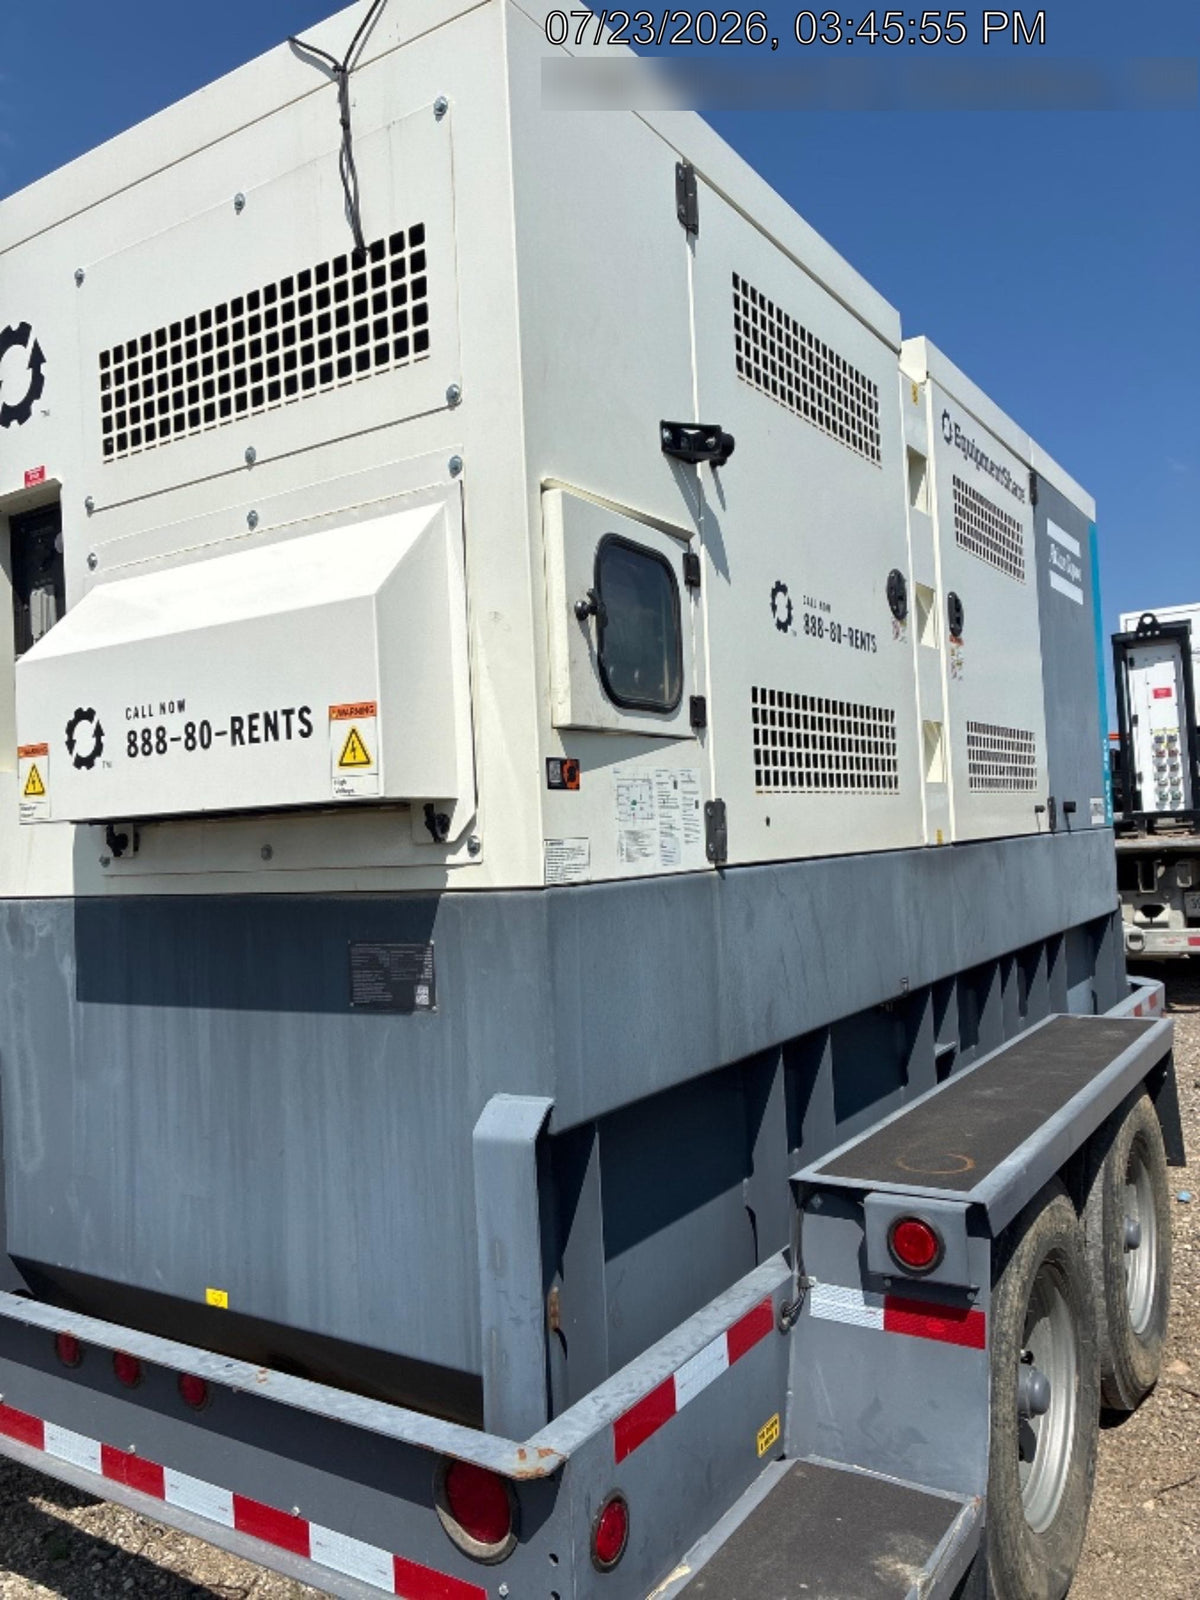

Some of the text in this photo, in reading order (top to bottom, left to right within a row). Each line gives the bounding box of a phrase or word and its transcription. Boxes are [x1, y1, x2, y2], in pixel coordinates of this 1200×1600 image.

[803, 612, 877, 653] 888-80-RENTS
[125, 698, 186, 720] CALL NOW
[338, 705, 374, 717] WARNING
[126, 705, 313, 758] 888-80-RENTS
